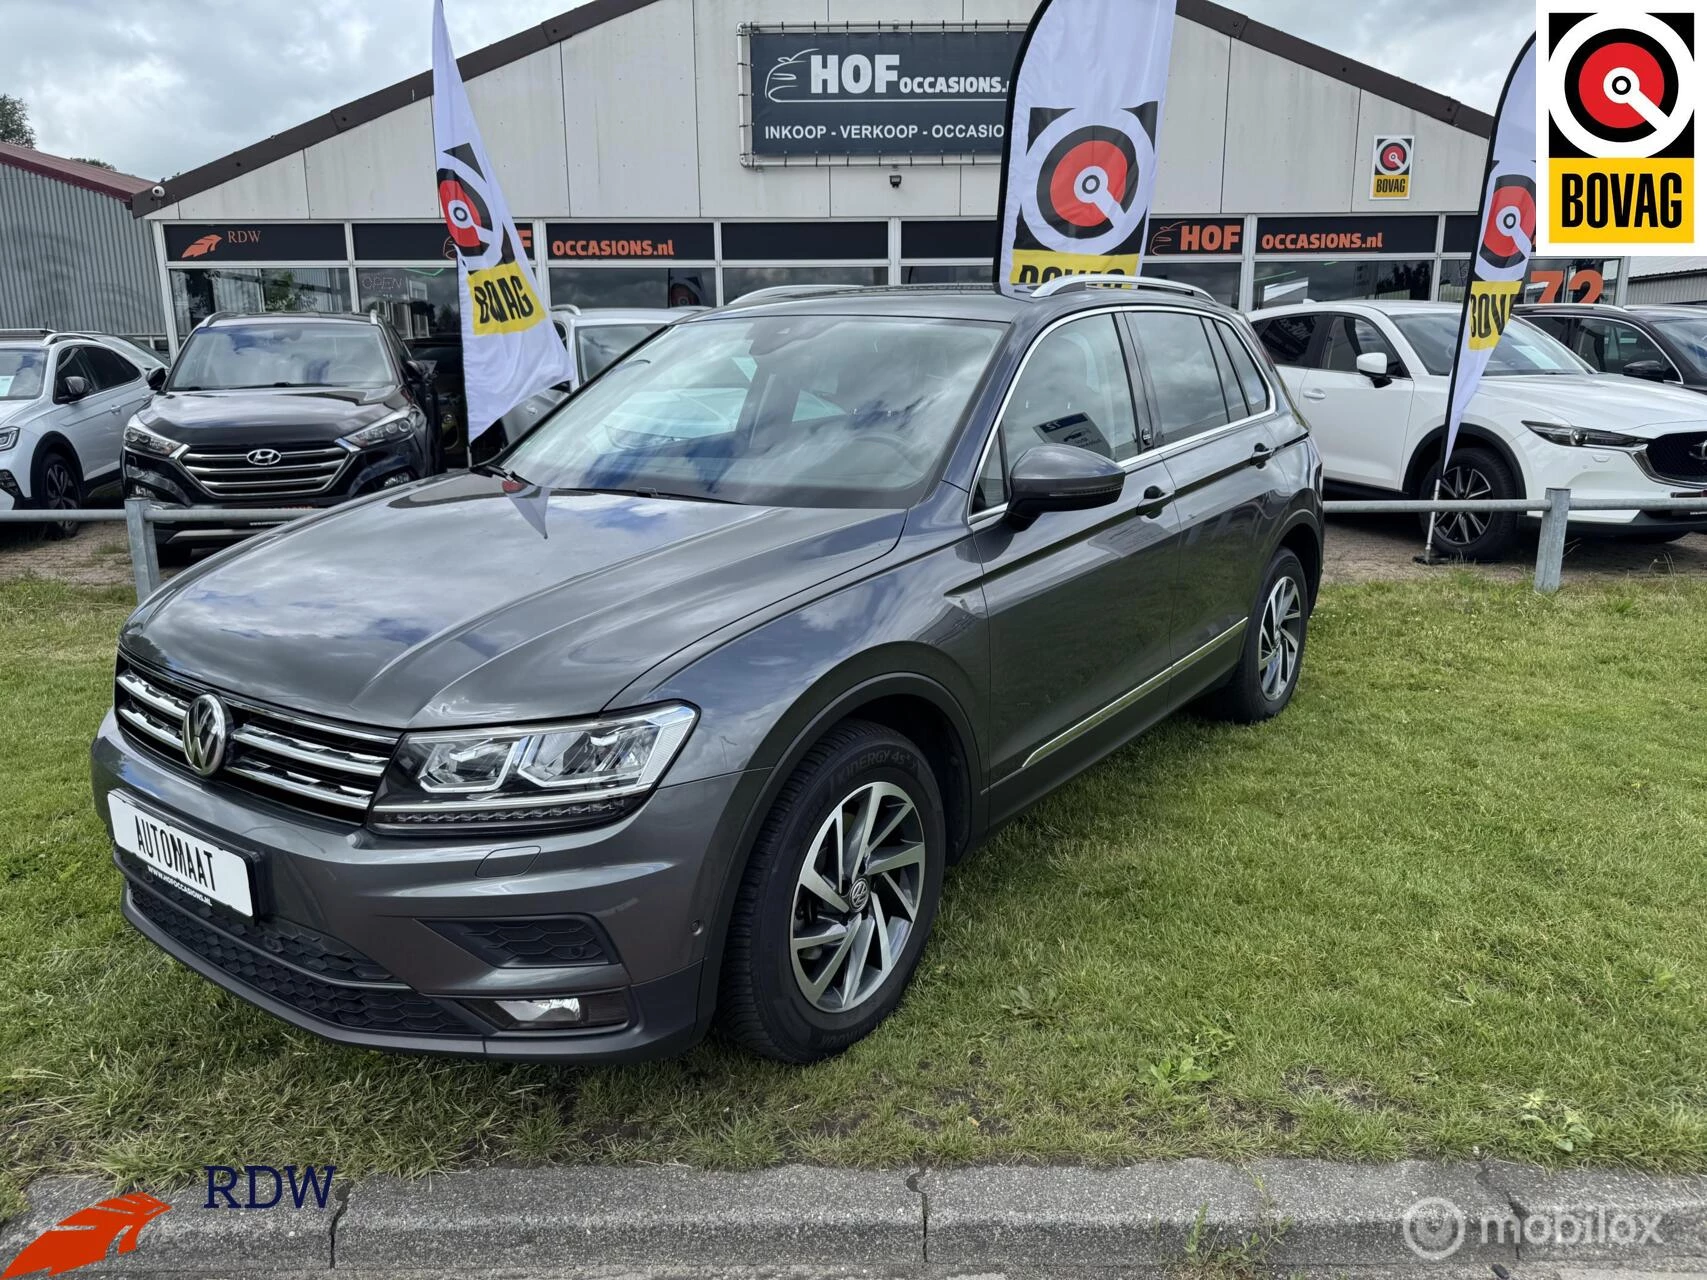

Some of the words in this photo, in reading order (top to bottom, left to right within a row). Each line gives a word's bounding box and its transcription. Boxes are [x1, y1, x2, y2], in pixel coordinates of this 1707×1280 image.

[810, 54, 900, 94] HOF
[899, 76, 1009, 94] OCCASIONS.
[765, 125, 827, 139] INKOOP
[840, 125, 918, 139] VERKOOP
[1376, 178, 1406, 193] BOVAG
[227, 230, 263, 244] RDW
[552, 239, 675, 257] OCCASIONS.nl
[1180, 225, 1241, 251] HOF
[1261, 232, 1383, 250] OCCASIONS.nl
[474, 275, 534, 324] BOVAG
[1530, 269, 1604, 304] 72
[134, 814, 216, 892] AUTOMAAT
